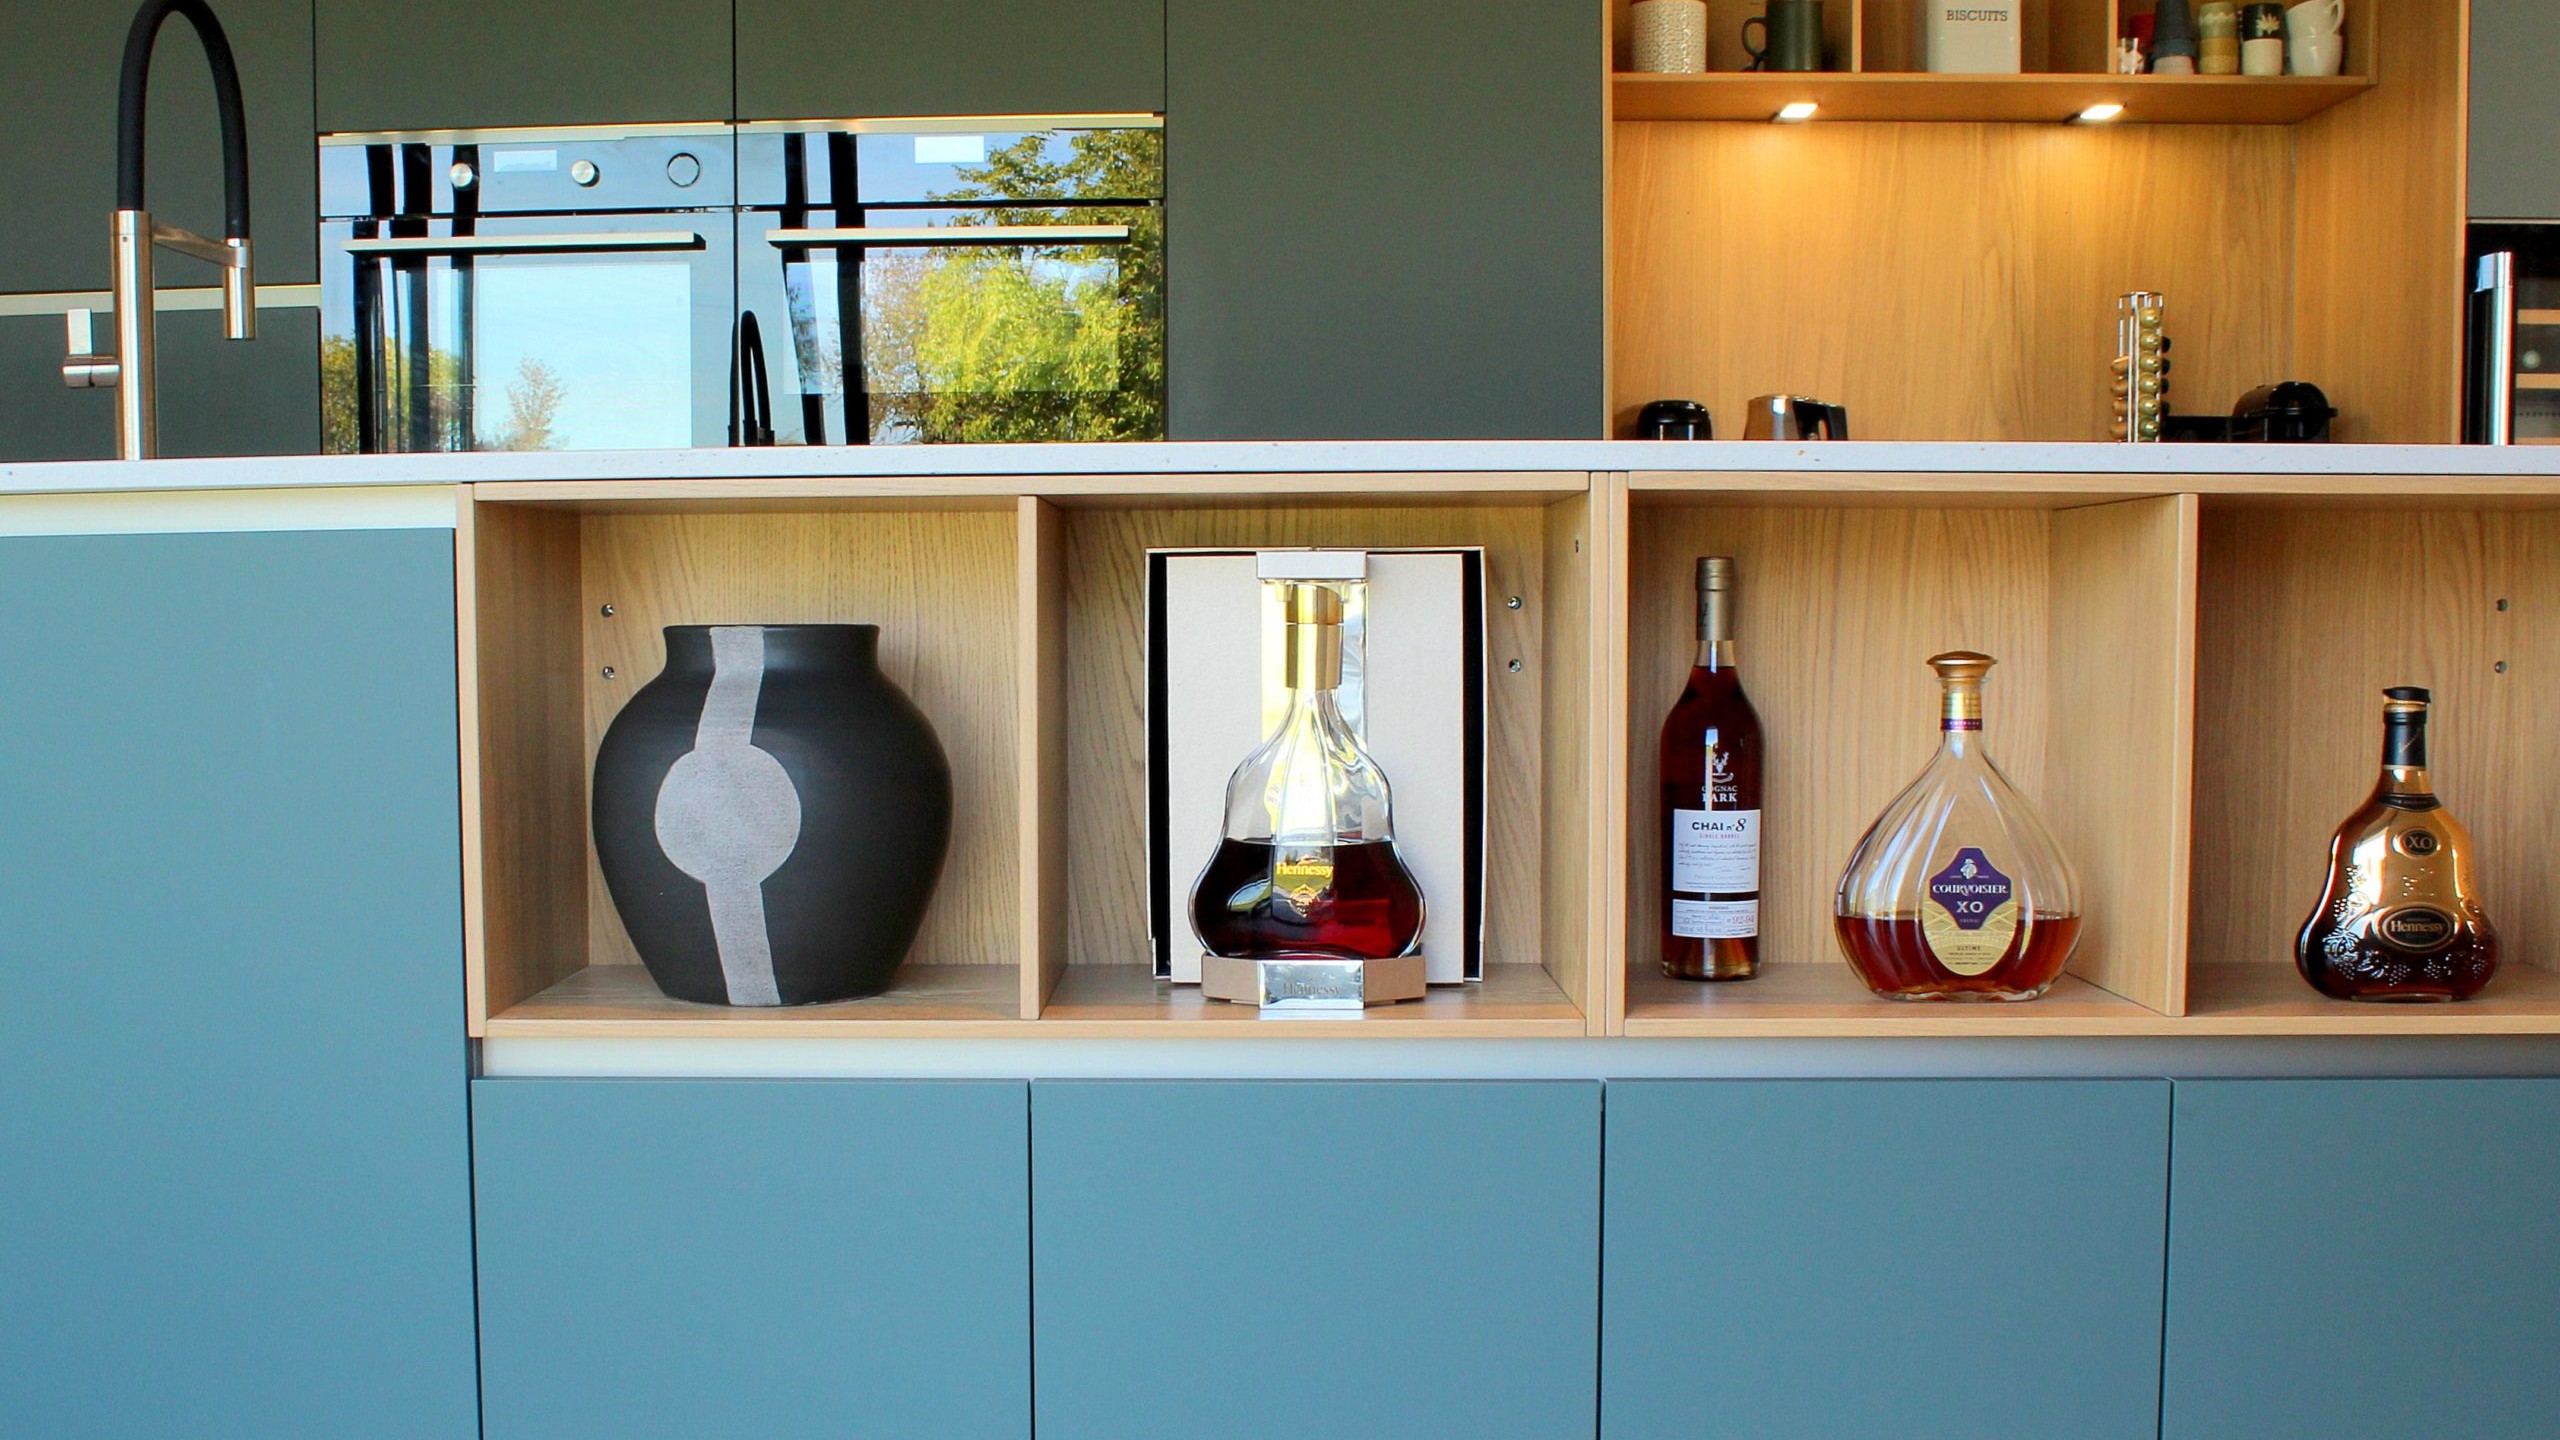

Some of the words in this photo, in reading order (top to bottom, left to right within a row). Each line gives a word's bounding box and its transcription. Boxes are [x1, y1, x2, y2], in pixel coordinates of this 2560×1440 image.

[1946, 10, 2008, 21] BISCUITS
[1692, 822, 1723, 831] CHAI
[1735, 818, 1746, 832] 8
[1276, 862, 1334, 878] Hennessy
[1932, 884, 2008, 896] COURVOISIER
[2391, 920, 2443, 935] Hennessy
[1283, 983, 1341, 997] Hennessy
